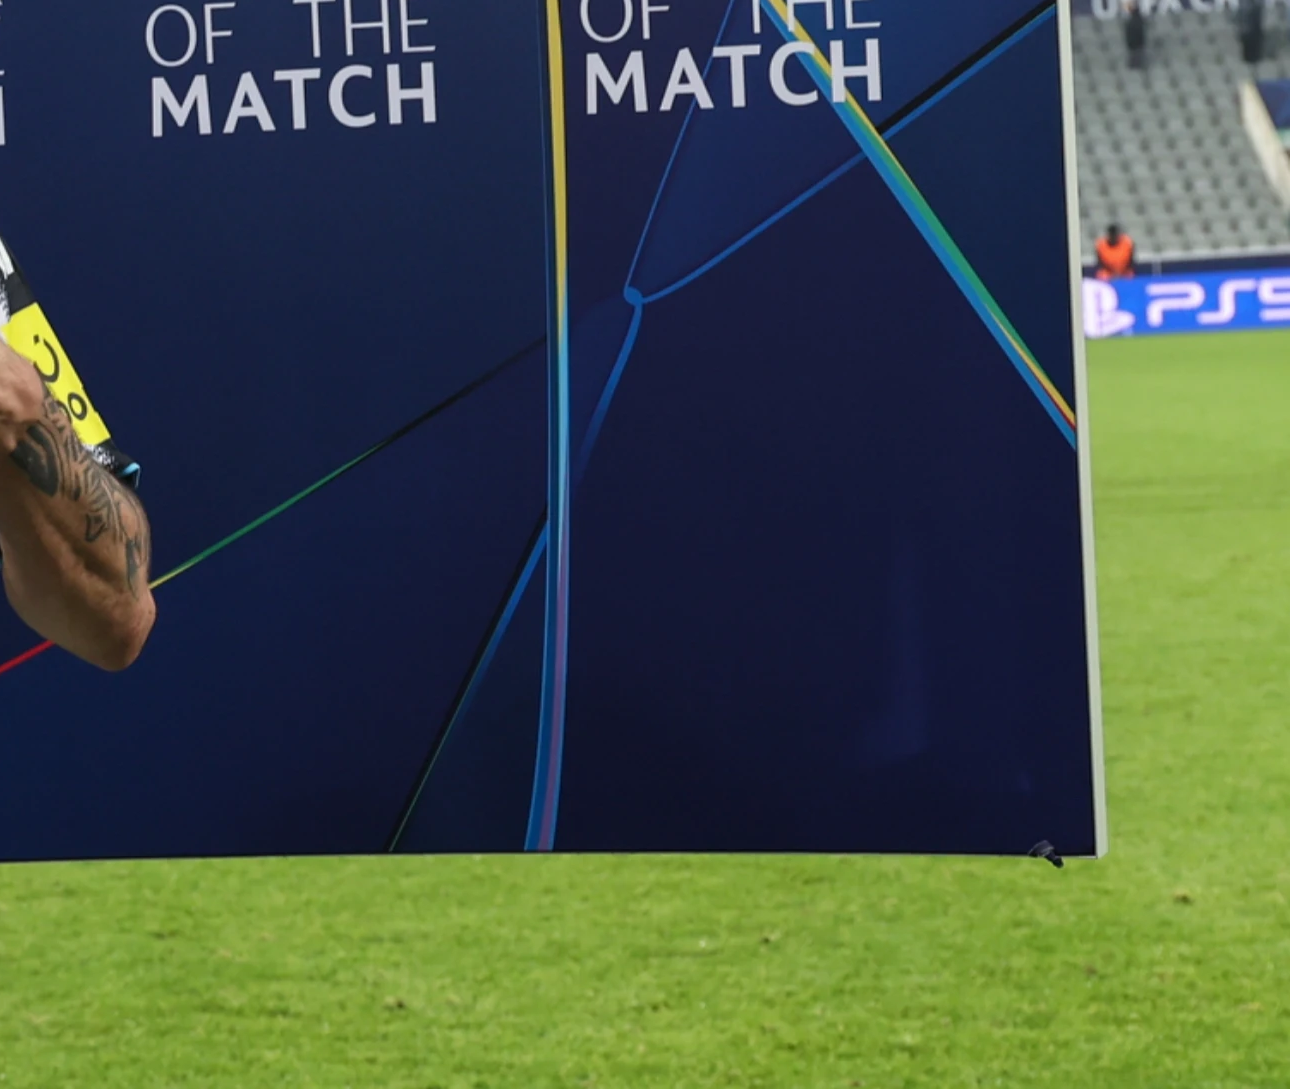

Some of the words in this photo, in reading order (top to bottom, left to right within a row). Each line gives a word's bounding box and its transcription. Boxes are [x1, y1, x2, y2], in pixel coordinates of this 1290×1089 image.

[145, 1, 237, 68] OF
[151, 61, 437, 138] MATCH
[586, 38, 882, 115] MATCH
